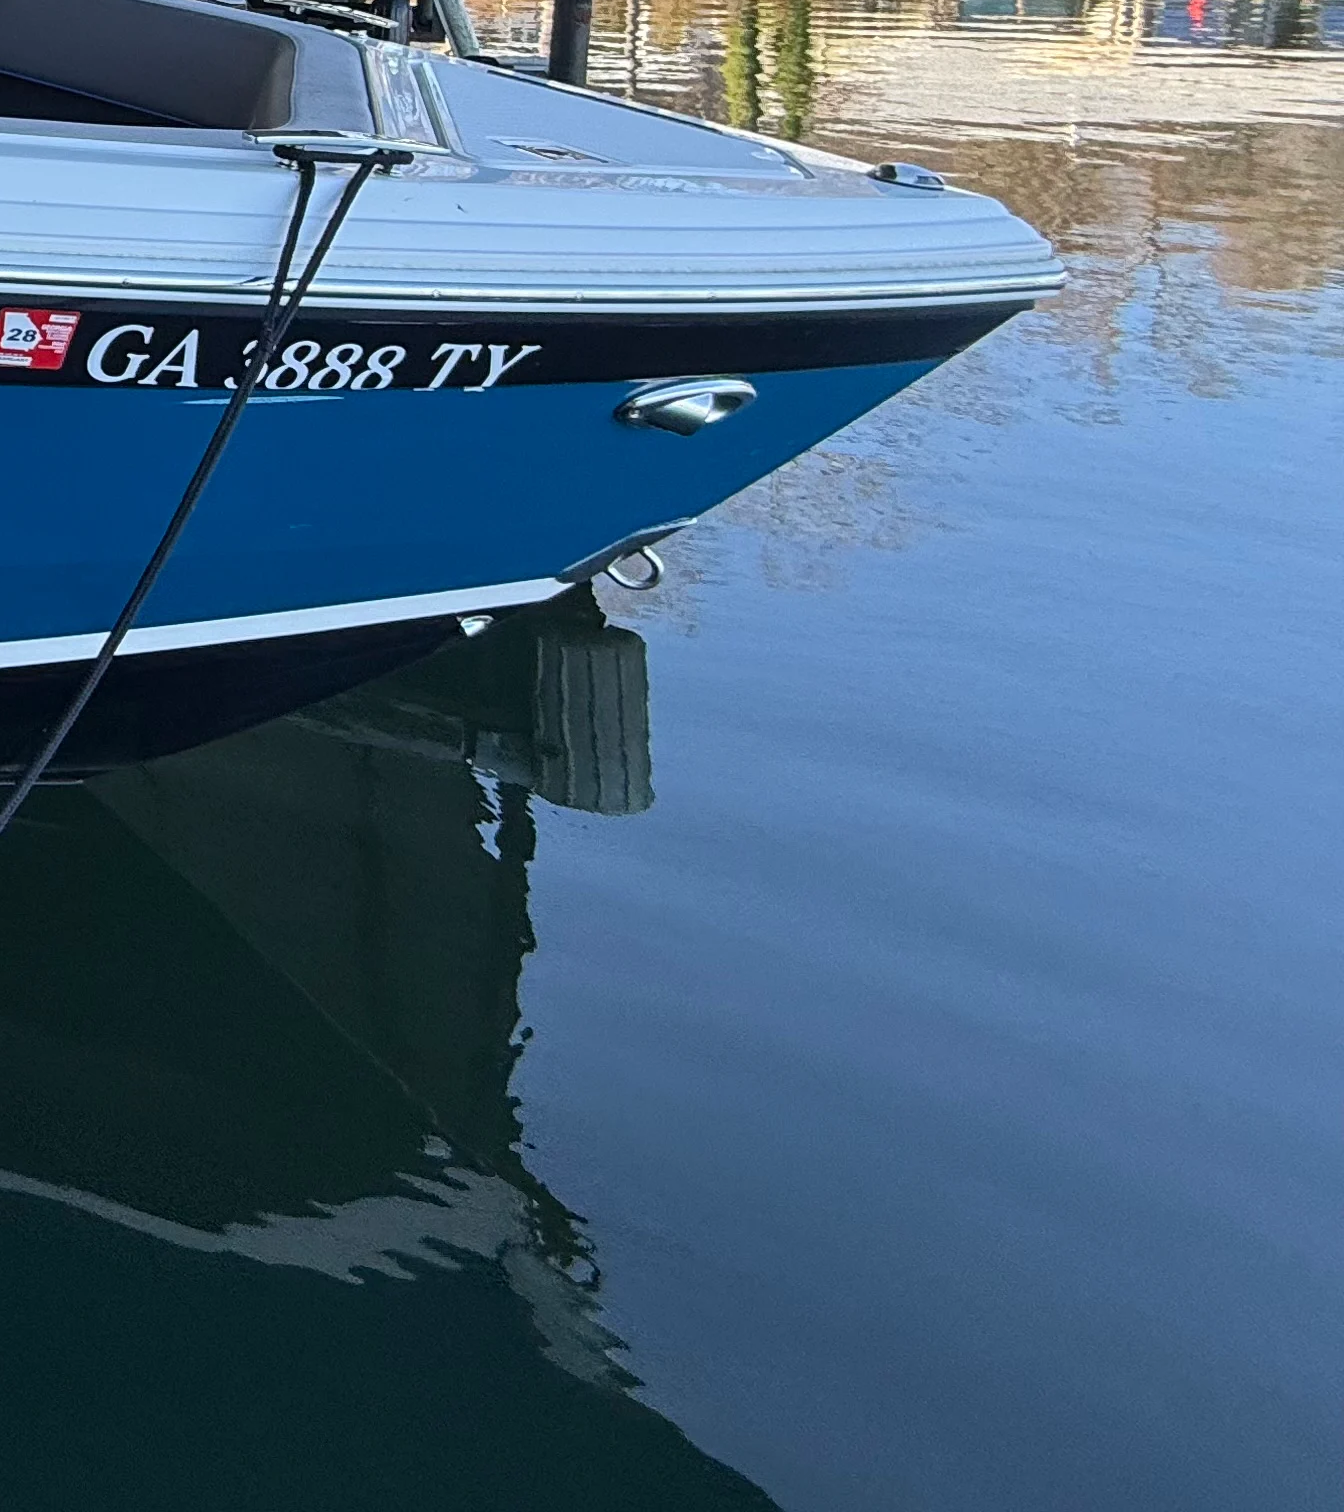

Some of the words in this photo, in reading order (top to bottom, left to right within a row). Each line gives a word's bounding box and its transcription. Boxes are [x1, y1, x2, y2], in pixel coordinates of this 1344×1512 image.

[6, 328, 37, 343] 28
[87, 324, 199, 388] GA
[413, 343, 543, 393] TY
